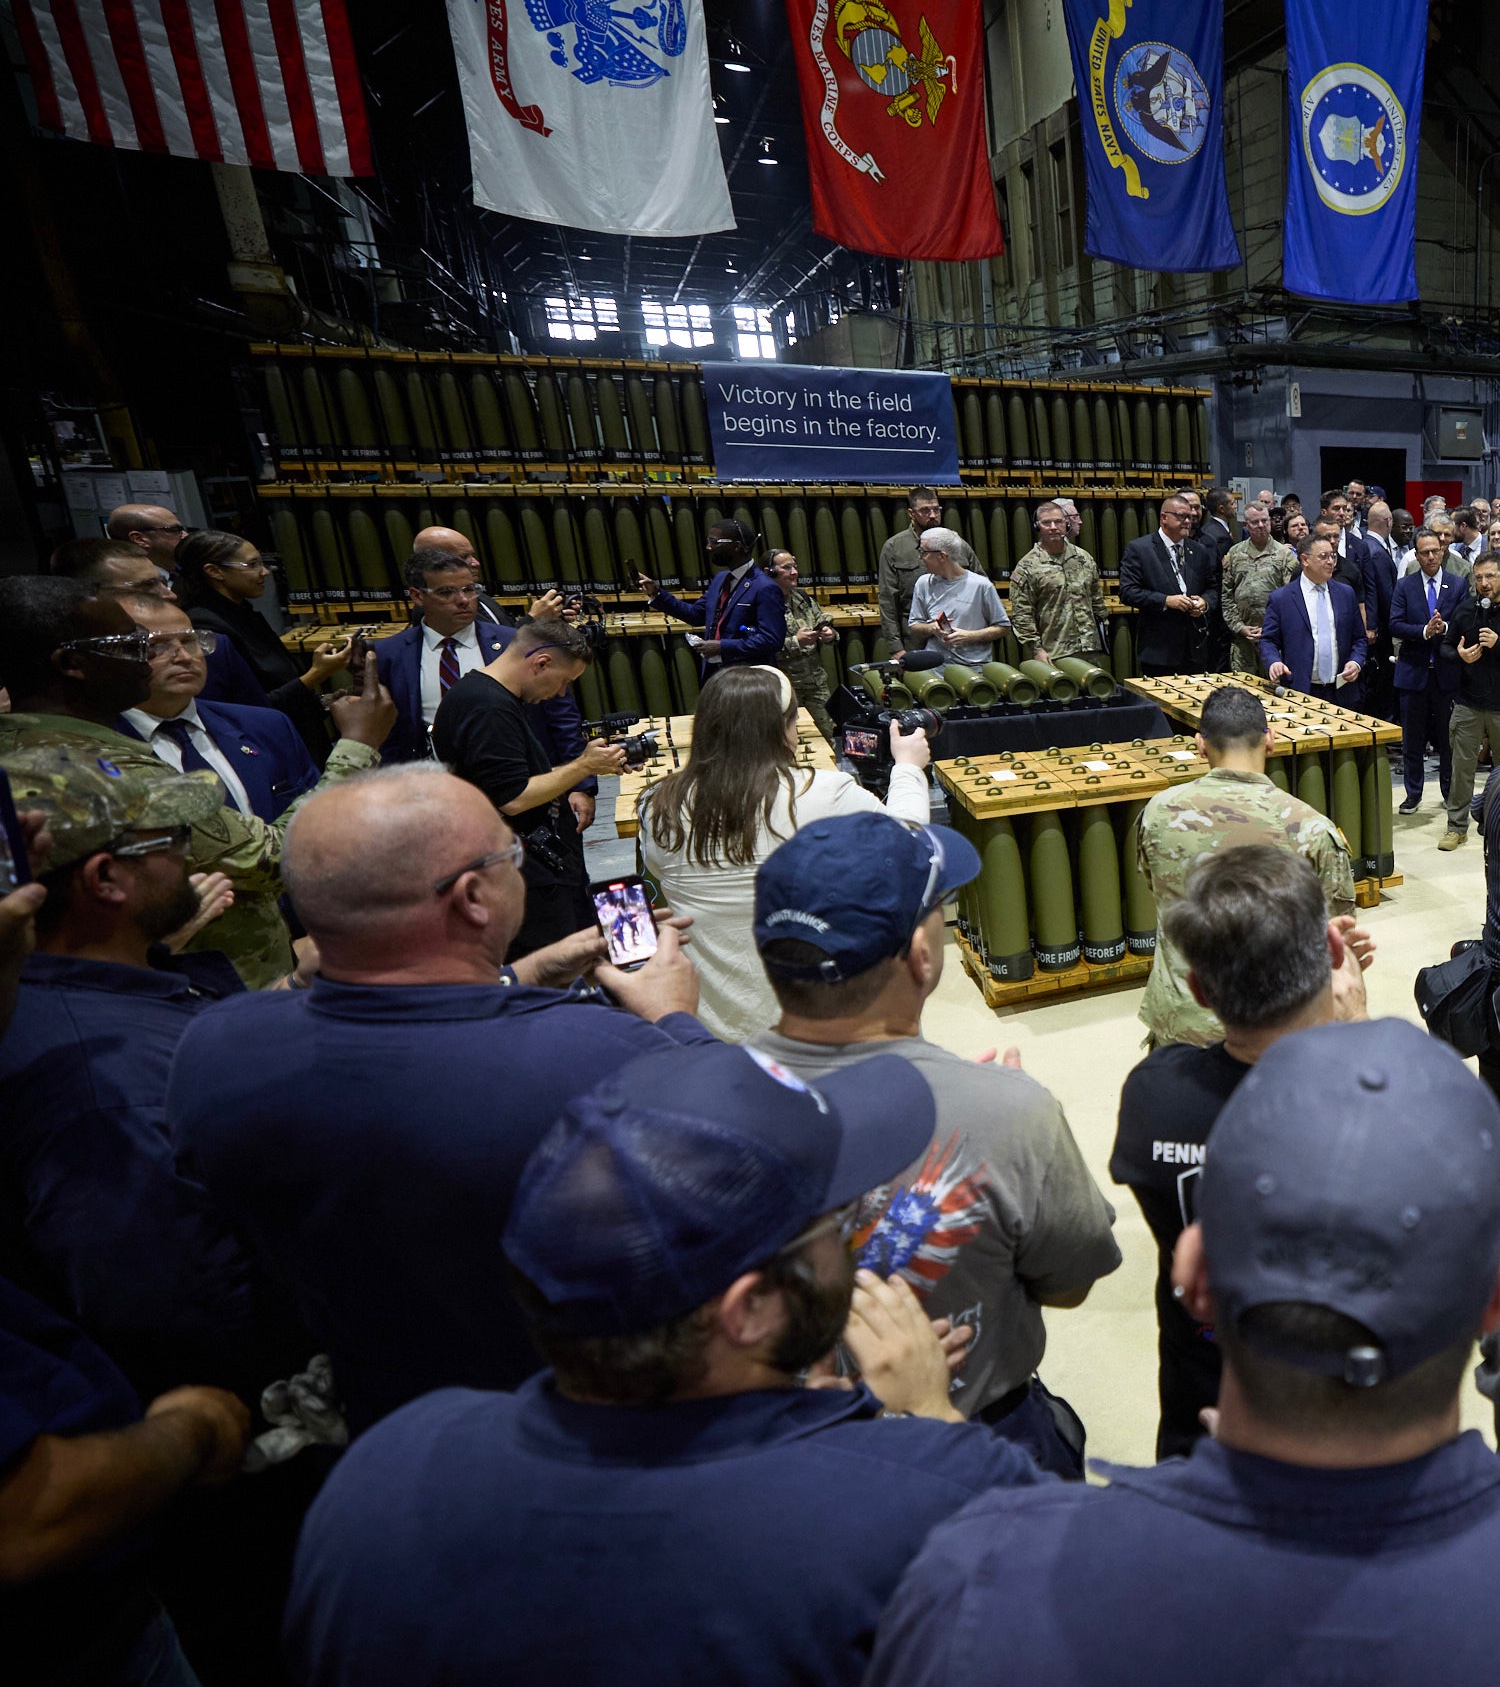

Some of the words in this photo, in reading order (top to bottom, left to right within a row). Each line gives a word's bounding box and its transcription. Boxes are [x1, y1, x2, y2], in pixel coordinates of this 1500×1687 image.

[1091, 26, 1108, 71] UNITED
[492, 37, 514, 101] ARMY
[815, 51, 838, 114] MARINE
[1093, 77, 1106, 117] STATES
[1385, 97, 1405, 145] UNITED
[823, 121, 860, 167] CORPS
[1101, 124, 1121, 158] NAVY
[1383, 147, 1404, 192] STATES
[719, 383, 798, 411] Victory
[804, 388, 822, 408] in
[828, 389, 862, 411] the
[867, 391, 913, 413] field
[723, 411, 798, 438] begins
[803, 416, 822, 436] in
[828, 417, 862, 438] the
[867, 418, 941, 445] factory.
[610, 717, 636, 727] DEITY
[1058, 945, 1080, 963] FIRING
[1085, 946, 1114, 959] BEFORE
[1130, 937, 1155, 948] FIRING
